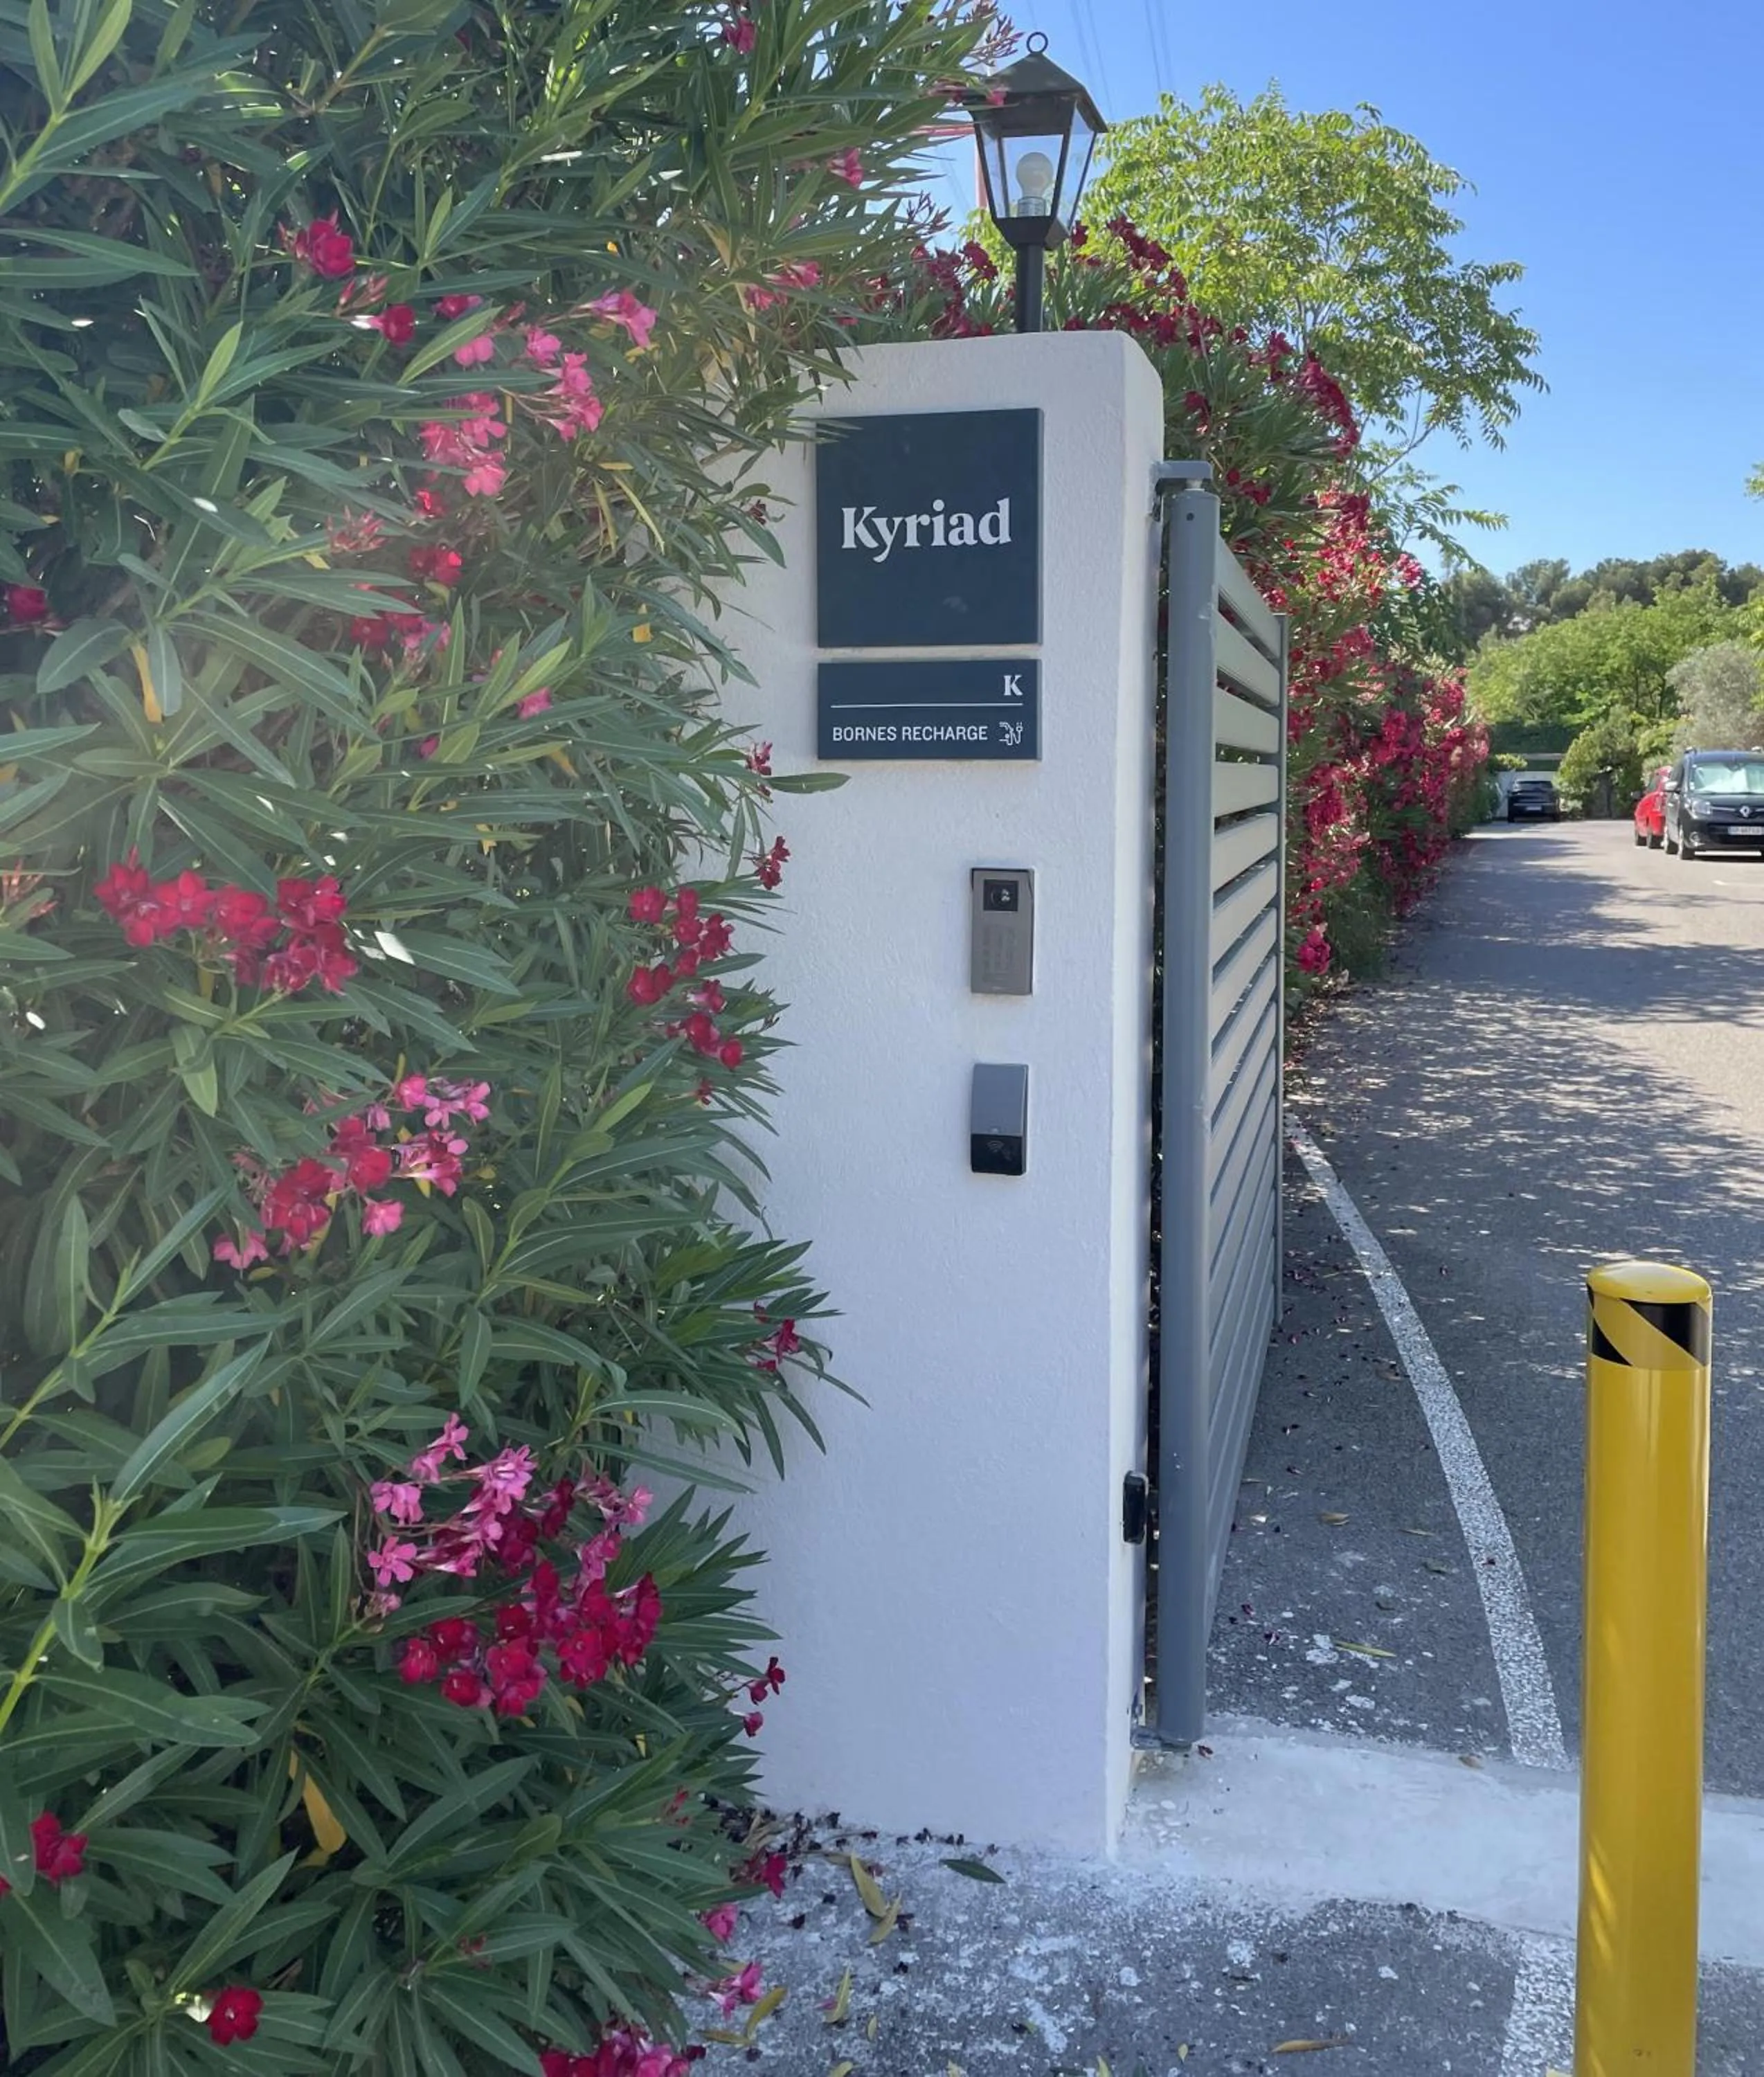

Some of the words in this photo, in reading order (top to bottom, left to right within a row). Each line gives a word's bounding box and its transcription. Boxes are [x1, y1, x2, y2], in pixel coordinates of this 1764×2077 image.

[841, 497, 1011, 563] Kyriad
[1003, 674, 1023, 696] K
[833, 726, 897, 741] BORNES
[901, 724, 989, 741] RECHARGE
